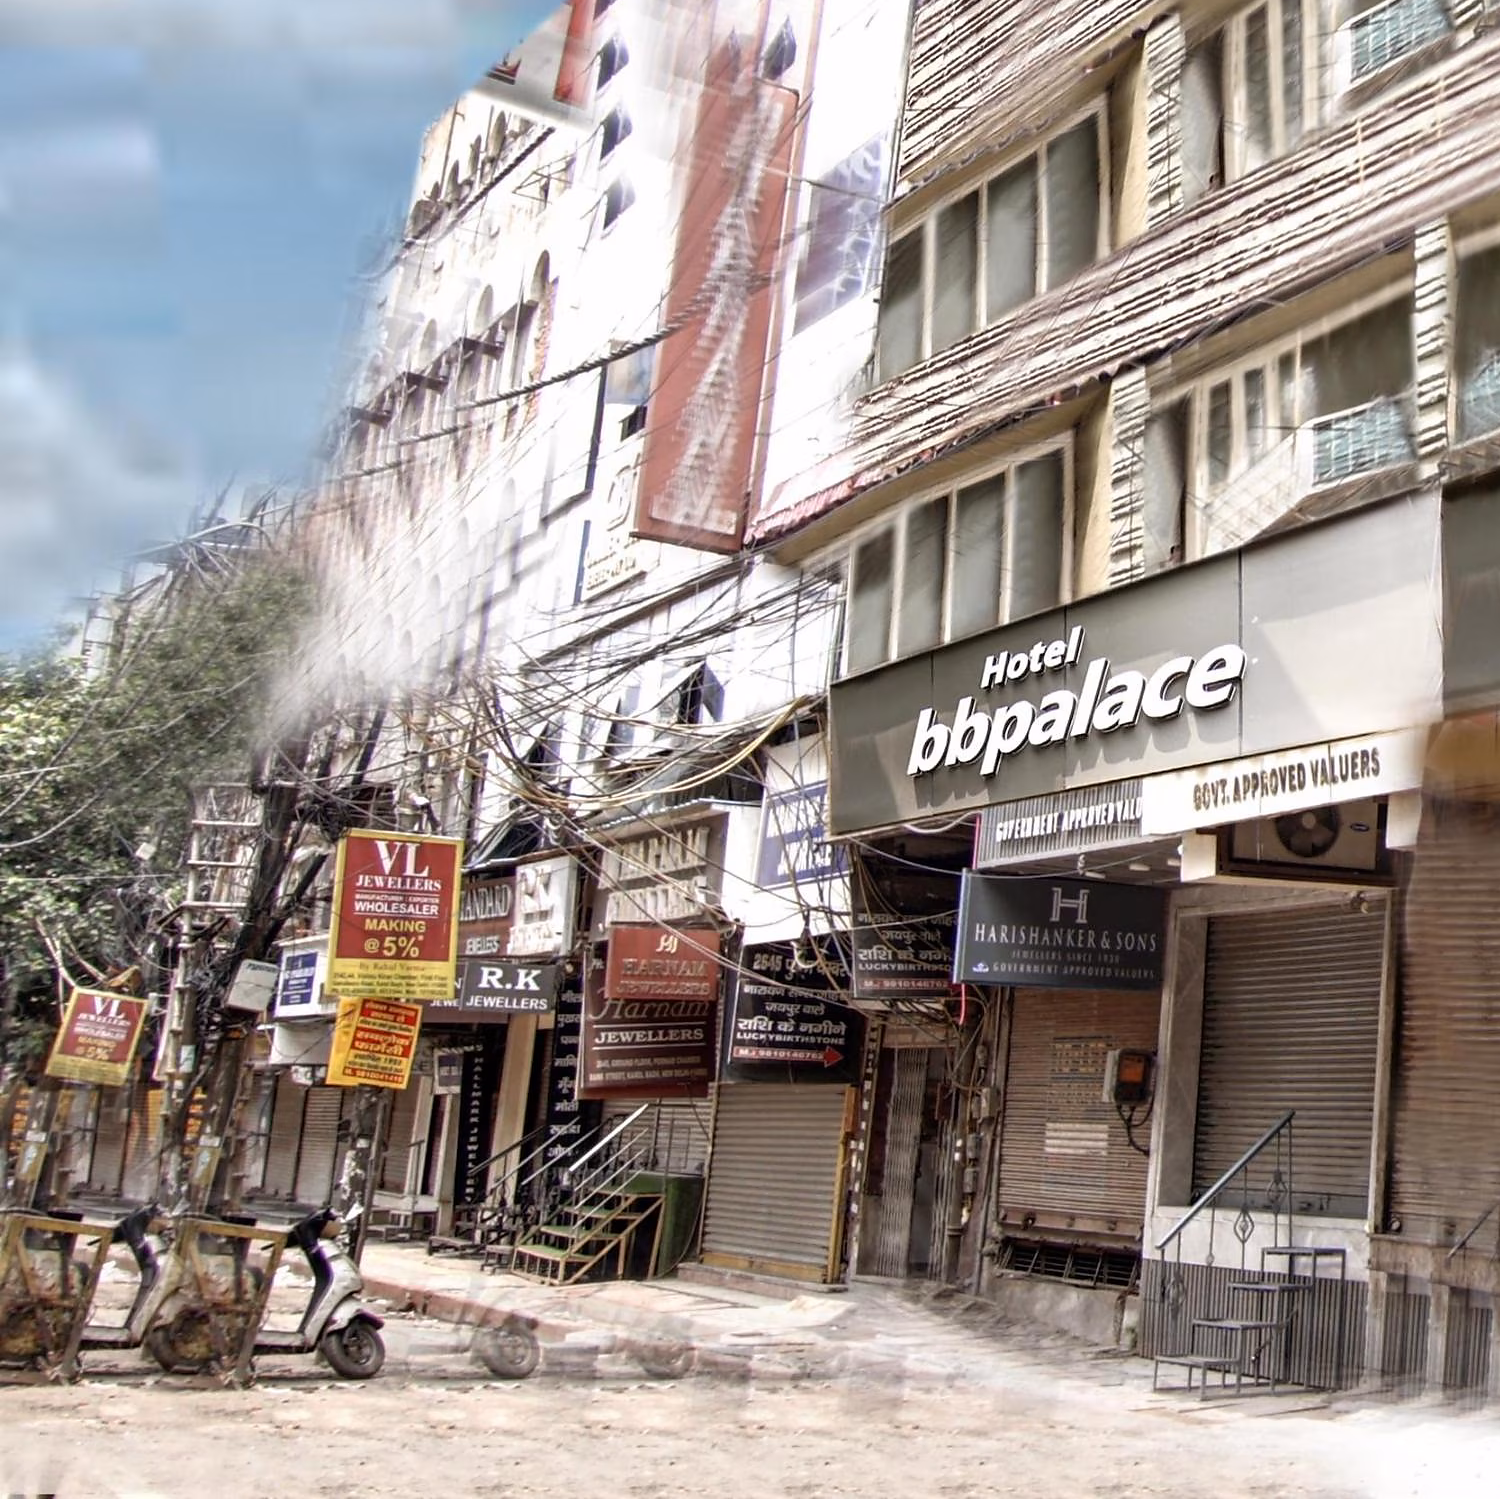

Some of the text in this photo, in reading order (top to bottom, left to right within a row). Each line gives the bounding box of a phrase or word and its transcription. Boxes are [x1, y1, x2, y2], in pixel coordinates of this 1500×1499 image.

[981, 626, 1085, 689] Hotel
[907, 644, 1247, 779] bbpalace
[1193, 747, 1380, 811] GOVT. APPROVED VALUERS
[996, 812, 1058, 842] GOVERNMENT
[1061, 802, 1114, 832] APPROVED
[374, 840, 430, 877] VL
[355, 875, 442, 892] JEWELLERS
[354, 901, 439, 915] WHOLESALER
[364, 918, 426, 932] MAKING
[975, 923, 1157, 951] HARISHANKER & SONS
[478, 966, 541, 990] R.K
[93, 996, 126, 1019] VL
[466, 995, 547, 1010] JEWELLERS
[737, 1015, 773, 1031] राशि
[595, 1029, 704, 1044] JEWELLERS
[465, 1127, 479, 1202] JEWELERS
